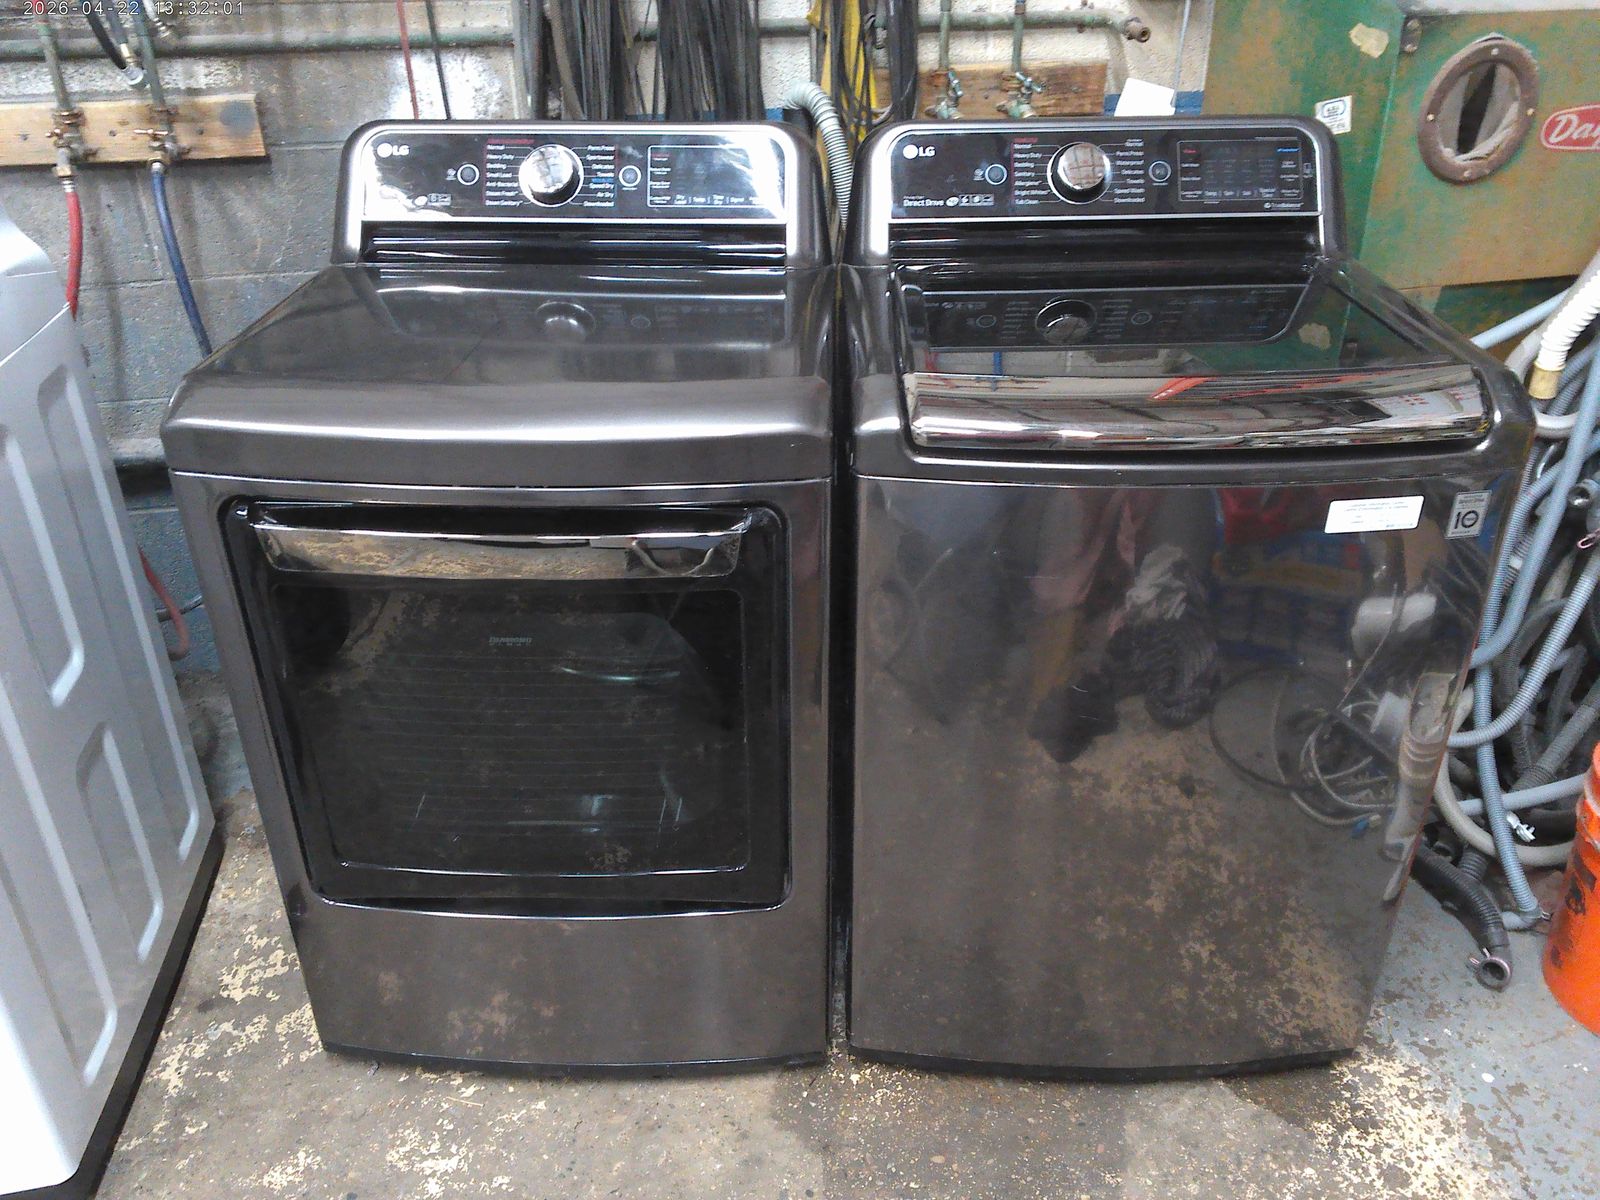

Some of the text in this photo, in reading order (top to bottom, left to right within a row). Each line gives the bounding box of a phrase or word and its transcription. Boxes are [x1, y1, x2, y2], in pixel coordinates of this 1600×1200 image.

[919, 146, 936, 157] LG
[903, 199, 944, 207] Direct Drive
[1455, 510, 1479, 529] 10
